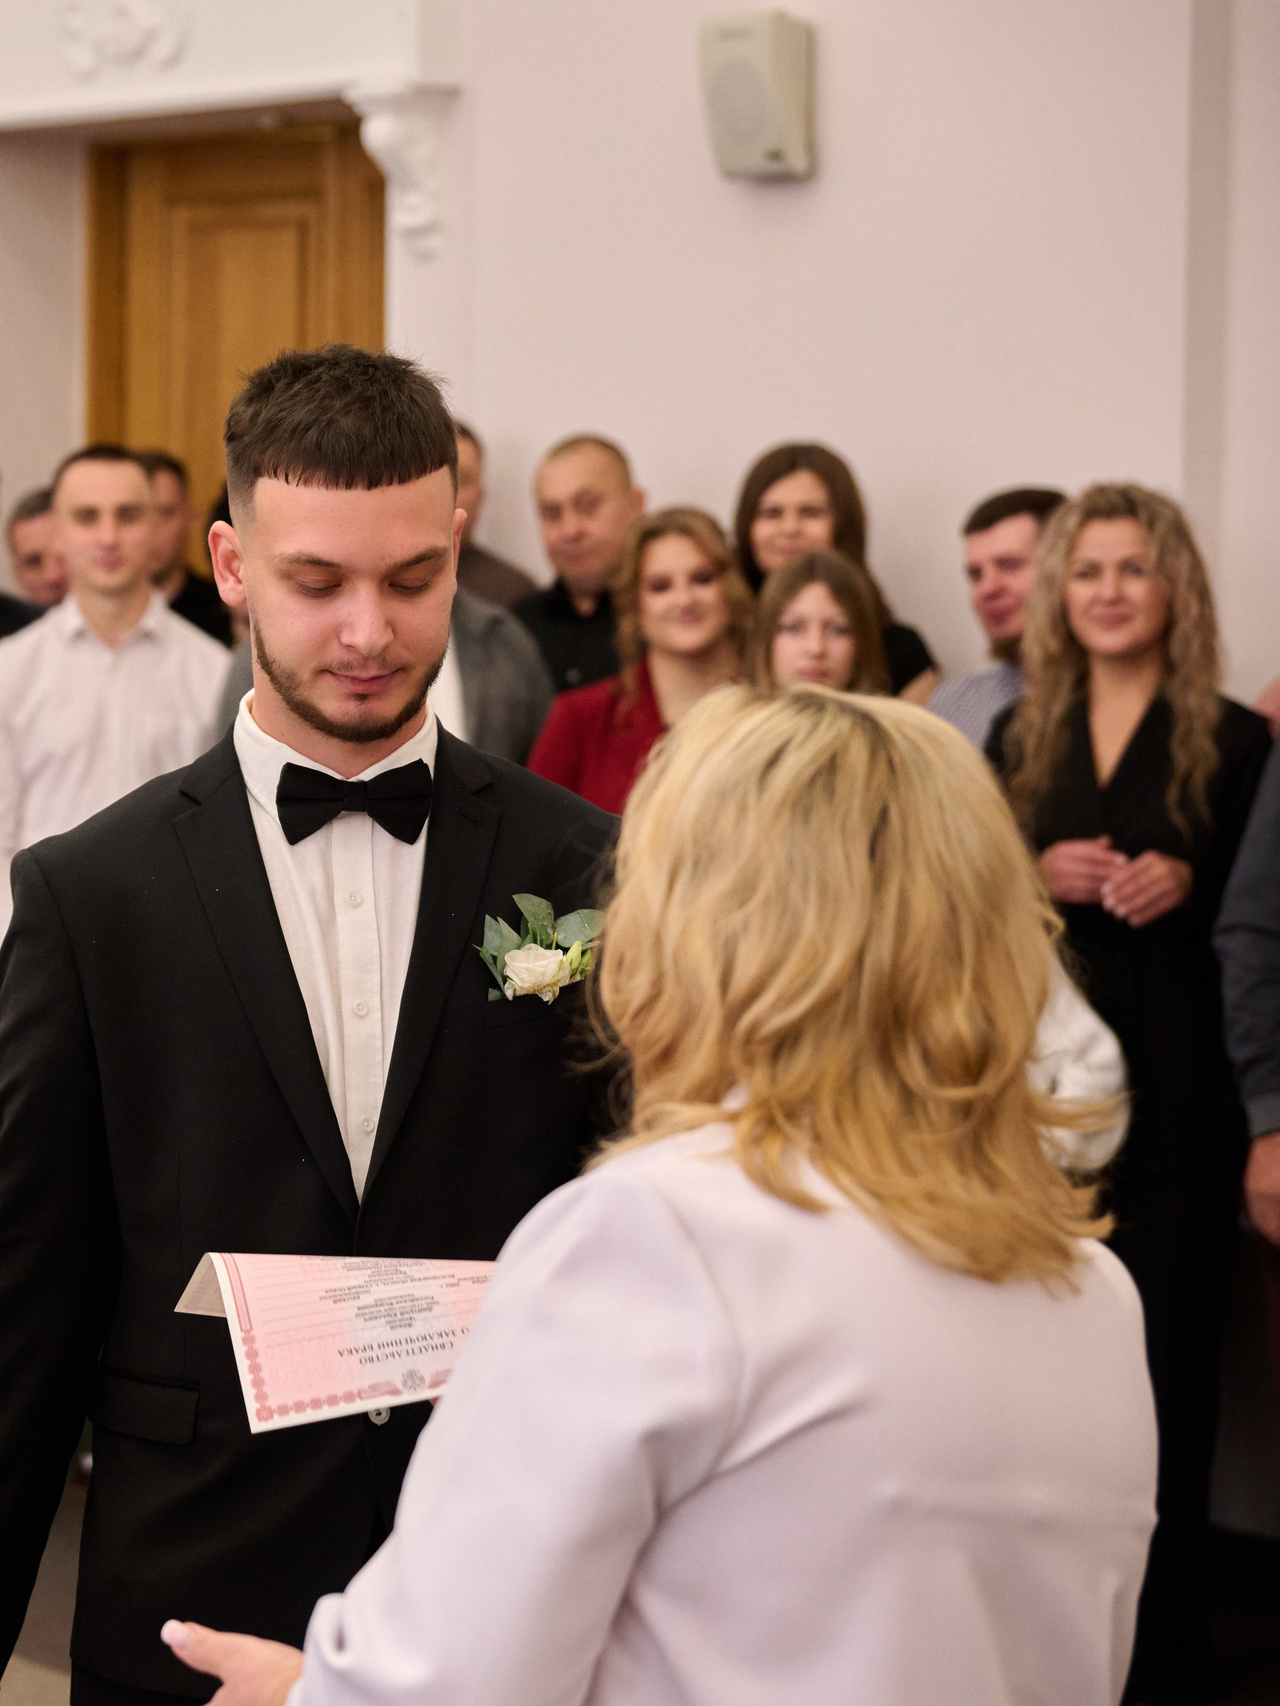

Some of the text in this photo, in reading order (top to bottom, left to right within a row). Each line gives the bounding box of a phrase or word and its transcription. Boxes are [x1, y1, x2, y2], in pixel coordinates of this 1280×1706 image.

[377, 1329, 456, 1349] ЗАКЛЮЧЕНИИ
[337, 1344, 373, 1358] БРАКА
[359, 1341, 454, 1365] СВИДЕТЕЛЬСТВО
